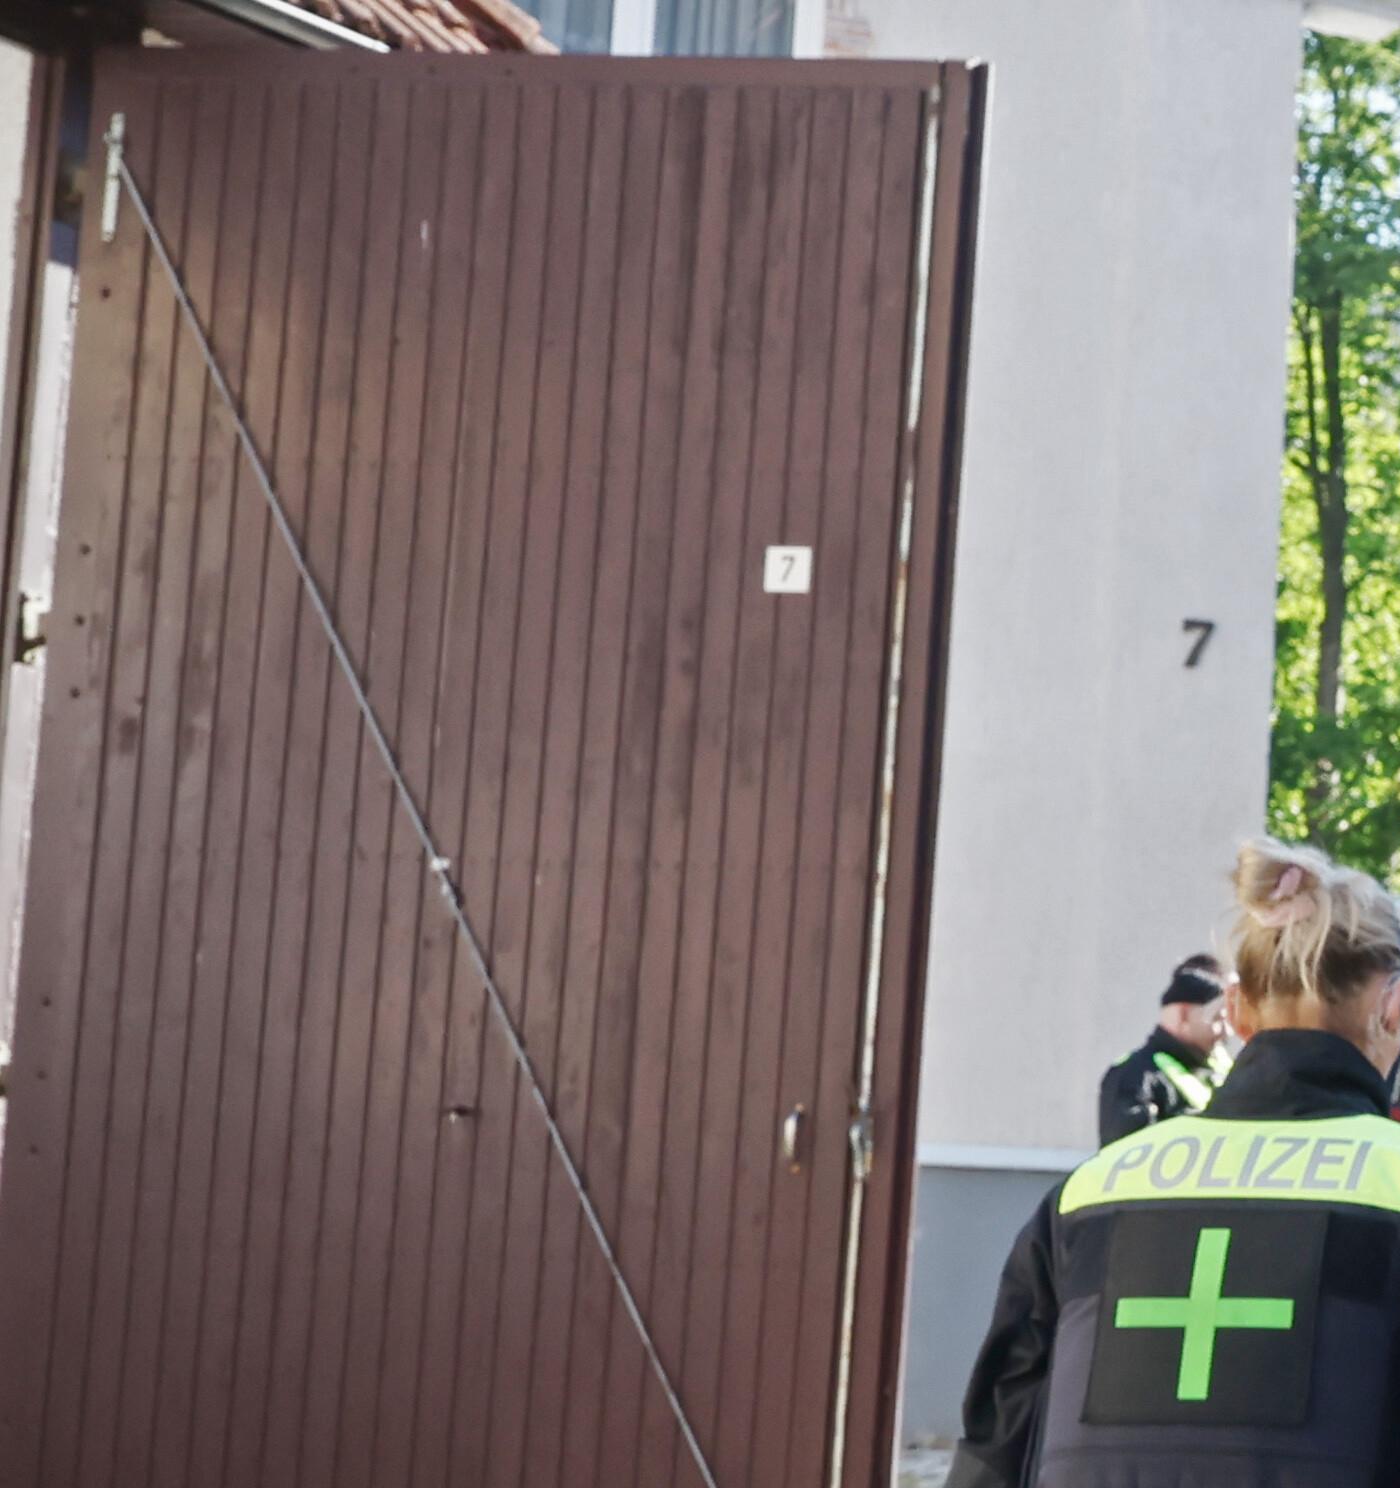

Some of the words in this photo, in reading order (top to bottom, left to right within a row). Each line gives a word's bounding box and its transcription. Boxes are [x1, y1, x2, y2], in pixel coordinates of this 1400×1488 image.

[780, 555, 796, 582] 7
[1181, 619, 1216, 669] 7
[1101, 1135, 1374, 1194] POLIZEI
